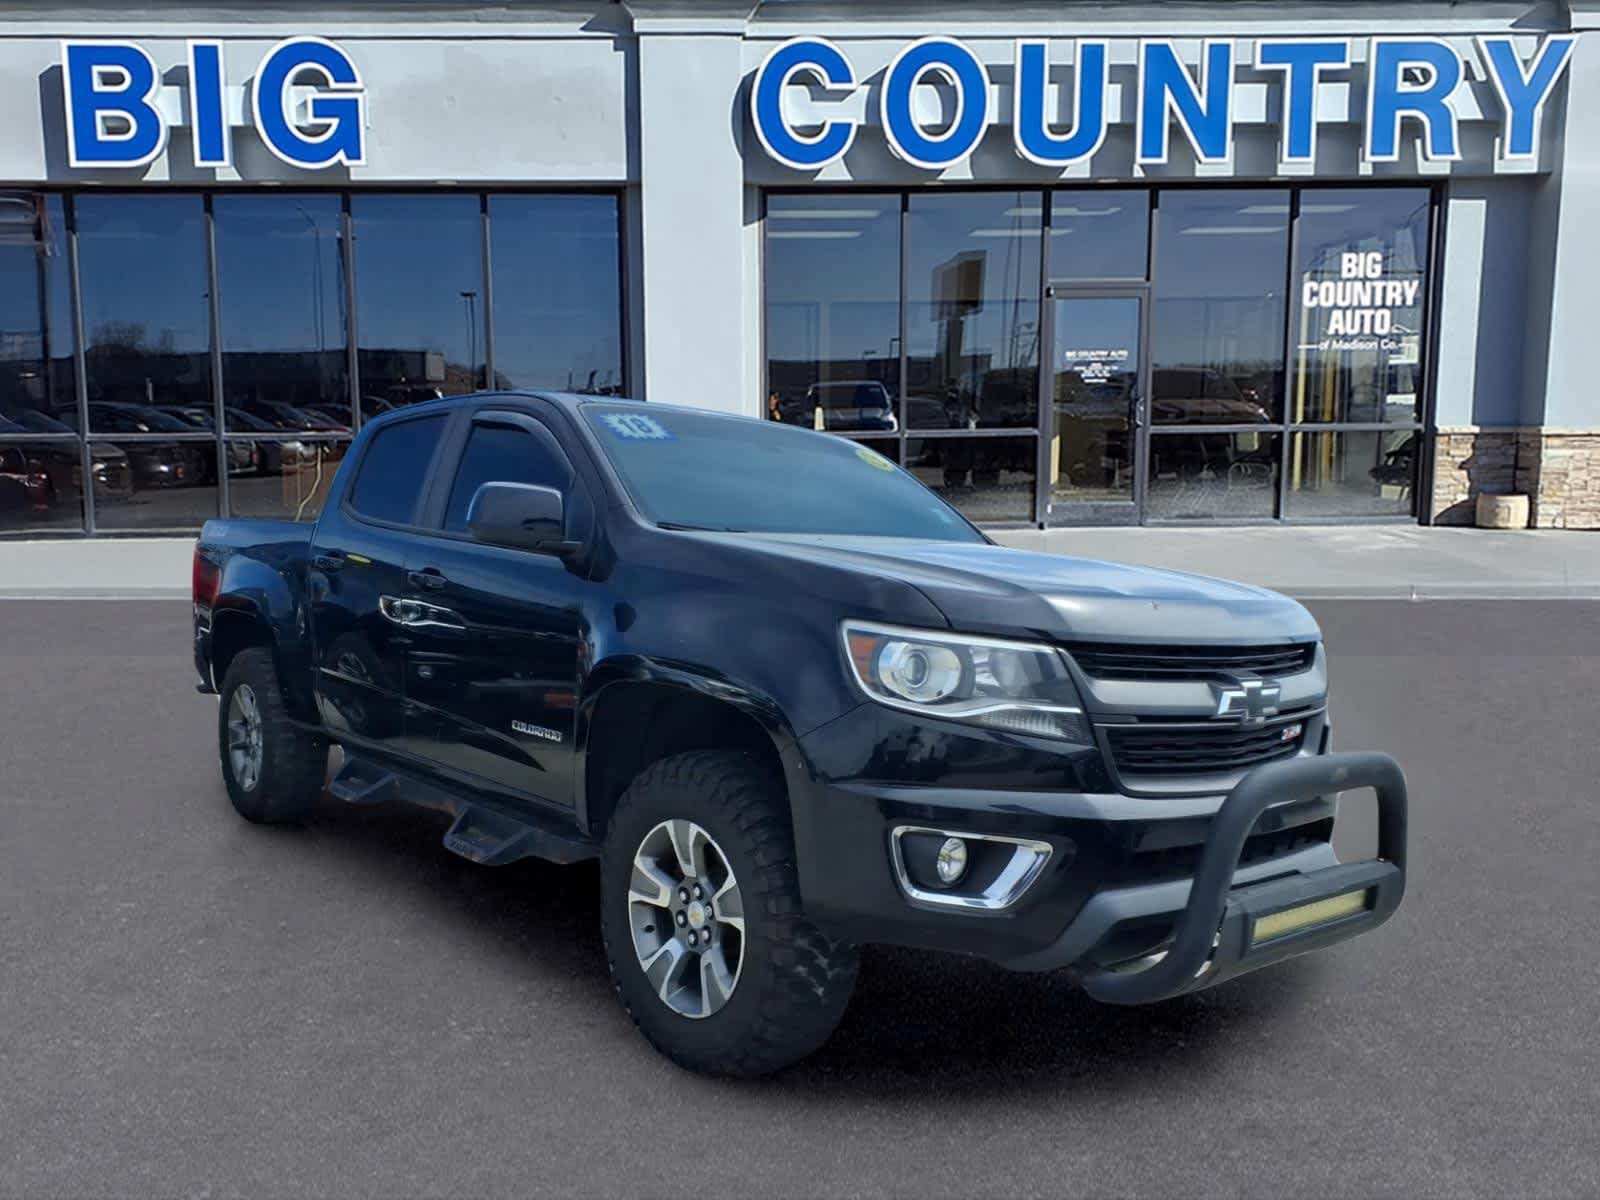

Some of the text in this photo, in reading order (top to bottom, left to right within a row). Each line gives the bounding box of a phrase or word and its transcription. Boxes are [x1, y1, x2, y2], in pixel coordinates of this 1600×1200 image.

[61, 35, 1577, 171] BIG COUNTRY
[1341, 251, 1382, 279] BIG
[1302, 280, 1420, 308] COUNTRY
[1327, 308, 1391, 335] AUTO
[1331, 339, 1378, 350] Madison
